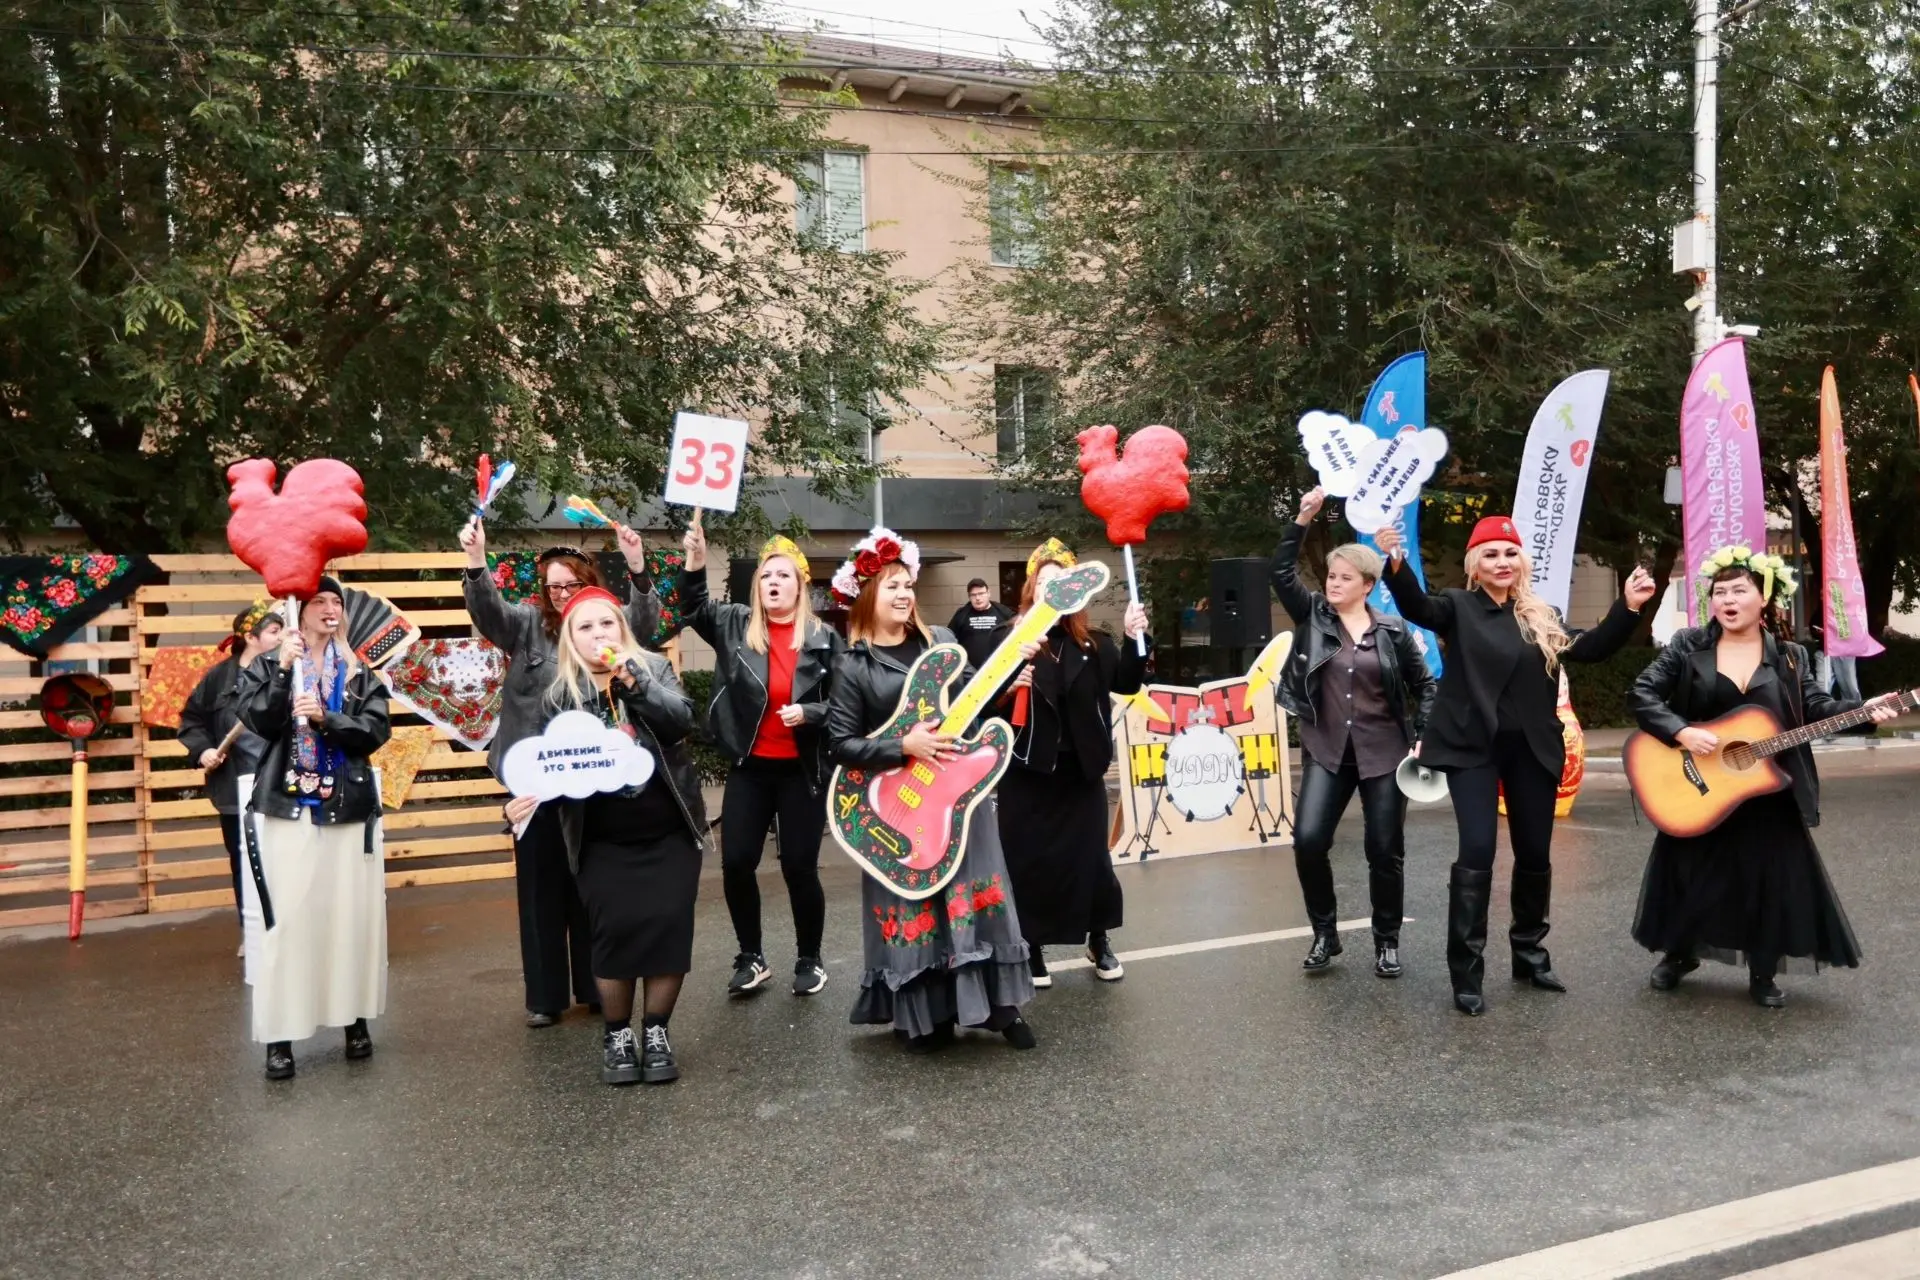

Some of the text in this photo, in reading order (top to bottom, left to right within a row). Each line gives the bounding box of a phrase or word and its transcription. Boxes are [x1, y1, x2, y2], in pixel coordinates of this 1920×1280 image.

[675, 438, 735, 490] 33
[1321, 442, 1342, 472] ЖМИ!
[1380, 466, 1398, 488] ЧЕМ
[1380, 457, 1420, 514] ДУМАЕШЬ
[1353, 488, 1368, 502] ТЫ
[537, 746, 602, 761] ДВИЖЕНИЕ
[543, 759, 615, 773] ЭТО ЖИЗНЬ!
